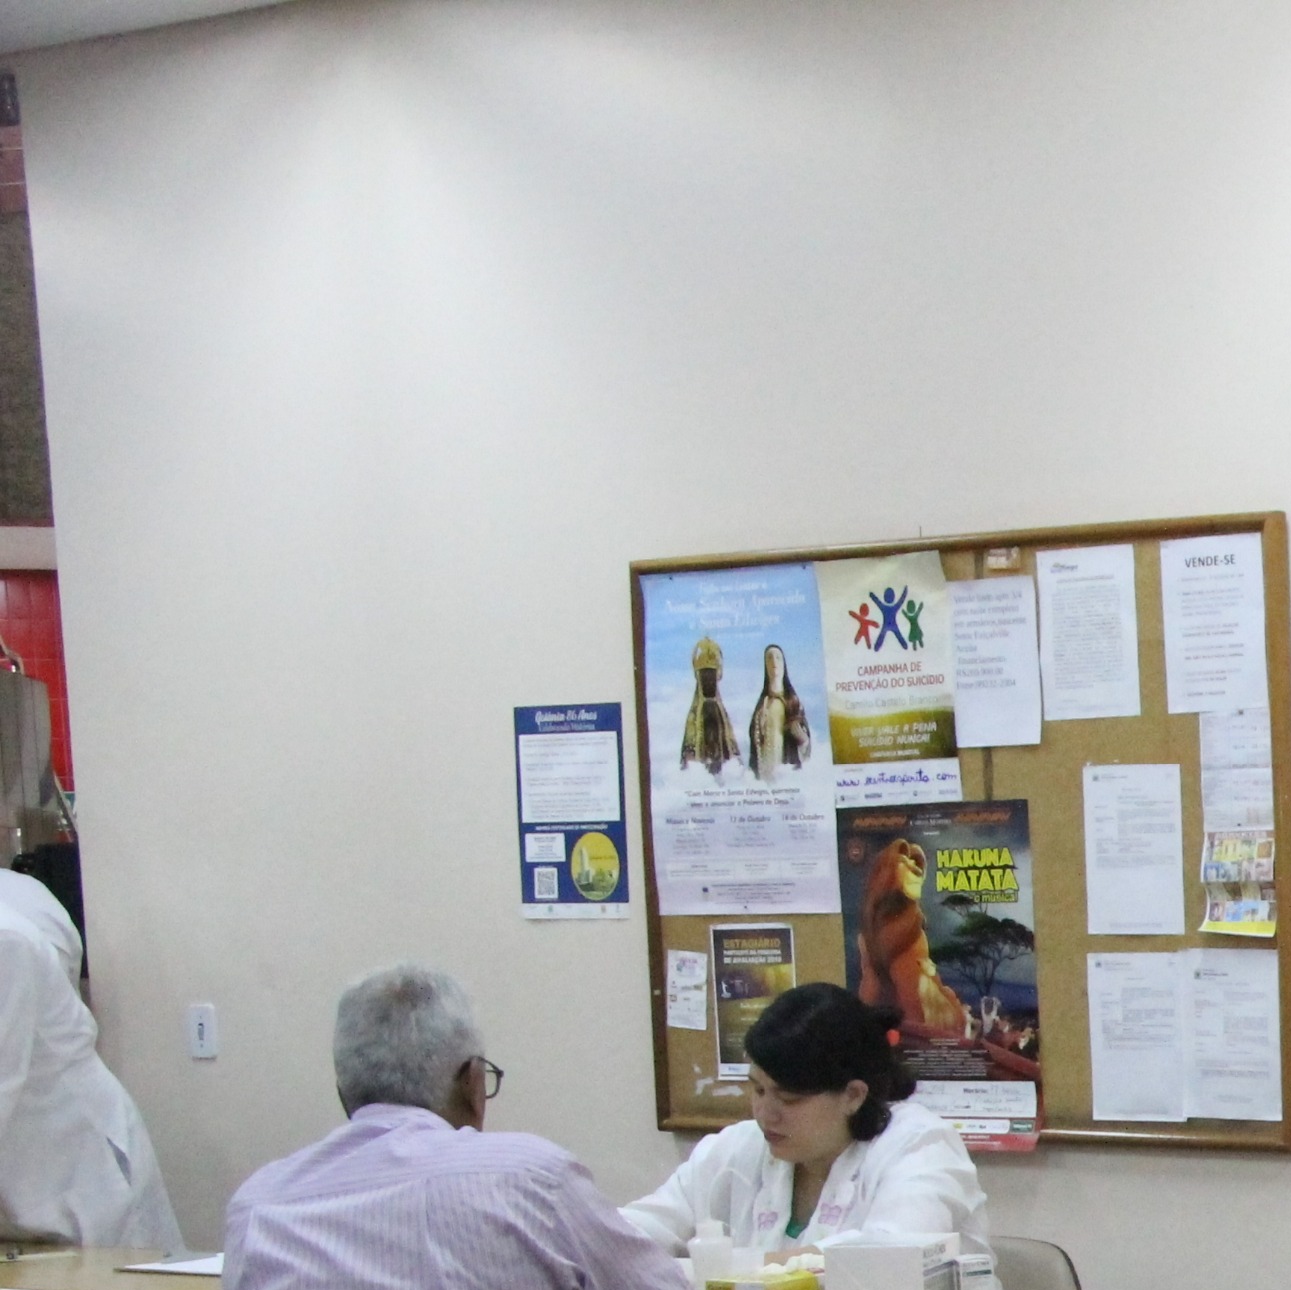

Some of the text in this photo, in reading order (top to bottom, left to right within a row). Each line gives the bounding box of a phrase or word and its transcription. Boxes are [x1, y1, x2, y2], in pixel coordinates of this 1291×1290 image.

[1184, 553, 1236, 569] VENDE-SE
[857, 661, 923, 677] CAMPANHA DE
[835, 673, 945, 693] PREVENÇÃO DO SUICÍDIO
[936, 847, 1014, 869] HAKUNA
[936, 868, 1020, 893] MATATA
